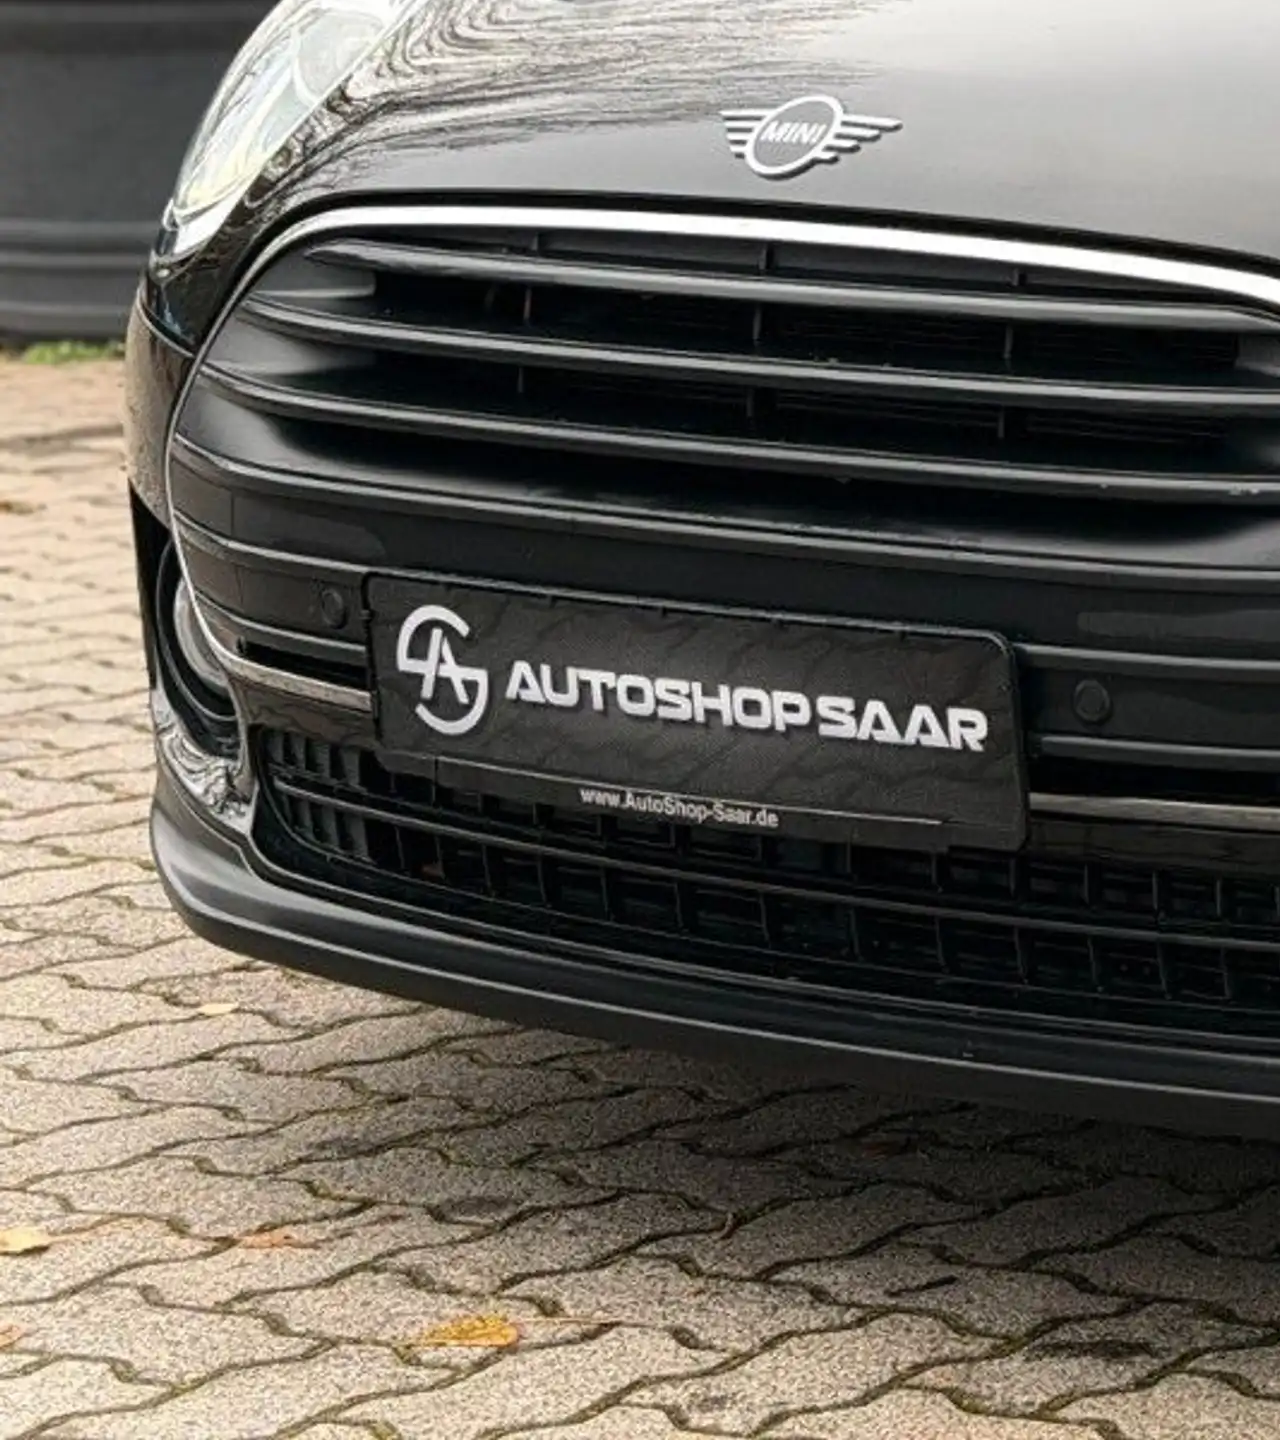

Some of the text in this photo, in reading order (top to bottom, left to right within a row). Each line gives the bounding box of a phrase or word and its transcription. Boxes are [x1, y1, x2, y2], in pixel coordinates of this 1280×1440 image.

[760, 119, 828, 144] MINI
[506, 660, 812, 732] AUTOSHOP
[818, 695, 989, 753] SAAR
[579, 787, 781, 828] www.AutoShop-Saar.de
